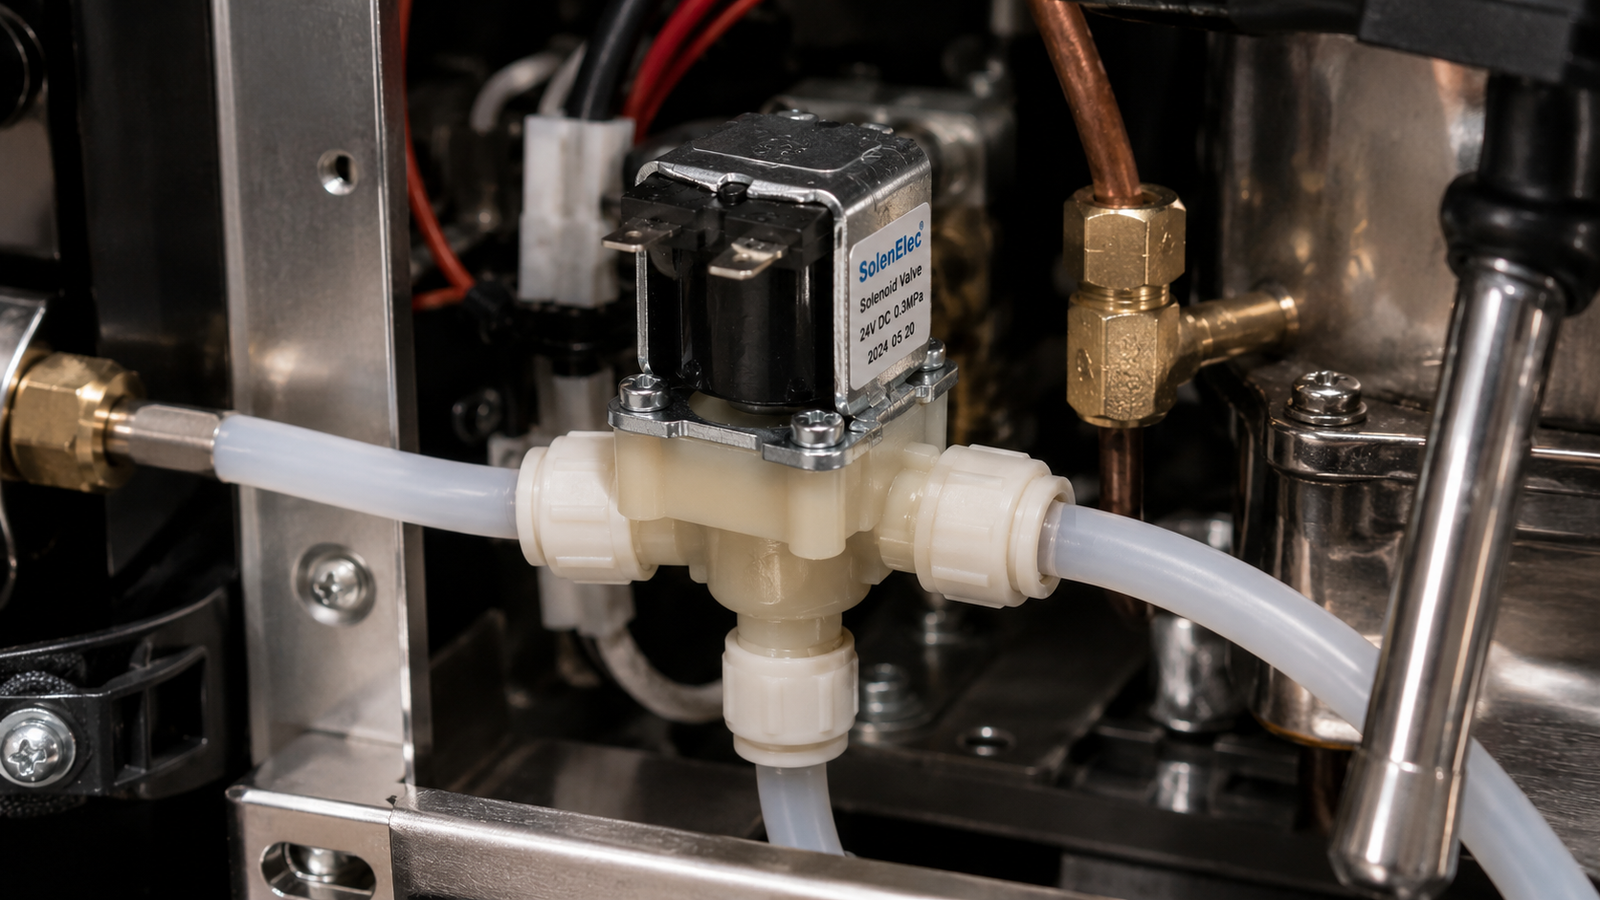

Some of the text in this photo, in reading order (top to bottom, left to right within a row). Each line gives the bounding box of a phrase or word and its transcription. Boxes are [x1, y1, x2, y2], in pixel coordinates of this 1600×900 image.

[860, 264, 922, 314] Solenoid Valve
[859, 291, 924, 343] 24V DC 0.3MPa
[867, 321, 915, 365] 2024 05 20
